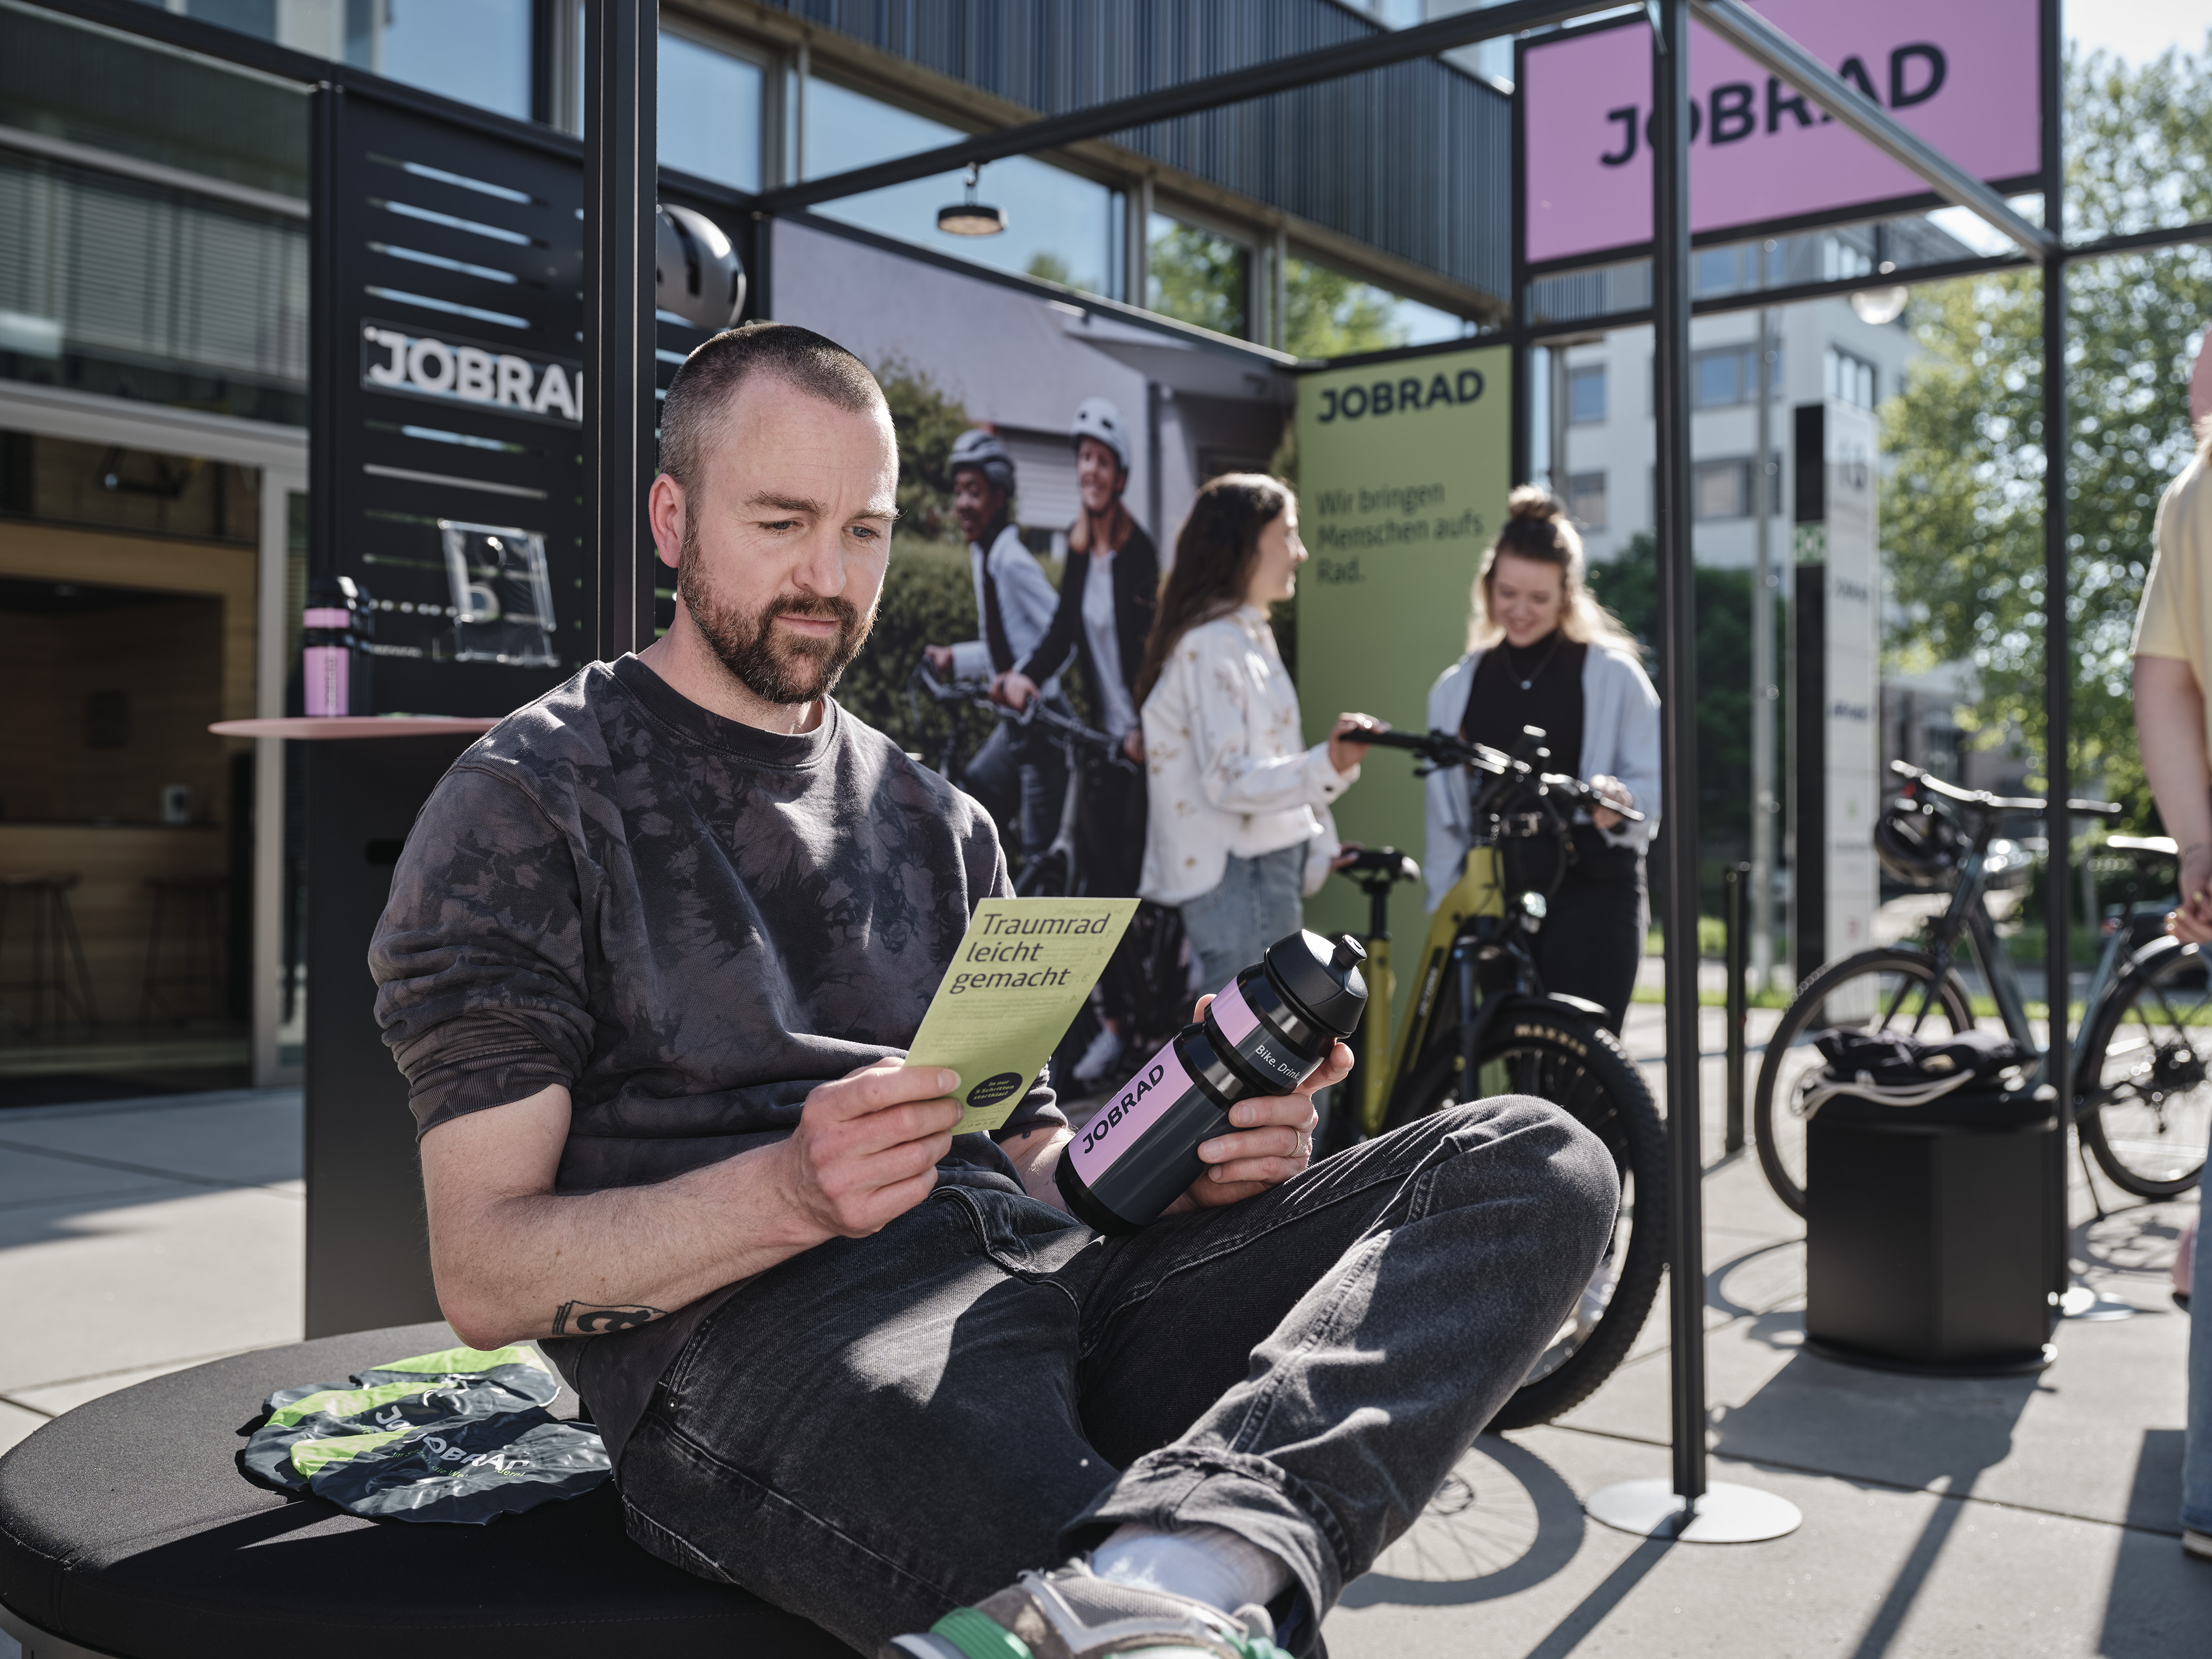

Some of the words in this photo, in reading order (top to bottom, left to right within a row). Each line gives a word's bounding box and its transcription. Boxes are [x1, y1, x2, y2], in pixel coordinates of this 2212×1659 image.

[368, 331, 583, 422] JOBRA
[1317, 369, 1485, 424] JOBRAD
[1317, 489, 1353, 517] Wir
[1358, 483, 1446, 517] bringen
[1317, 519, 1430, 550] Menschen
[1434, 508, 1485, 541] aufs
[1317, 556, 1366, 585] Rad.
[982, 914, 1111, 935] Traumrad
[966, 941, 1044, 962] leicht
[949, 967, 1072, 994] gemacht
[1255, 1045, 1276, 1067] Bike.
[1277, 1063, 1300, 1080] Drink.
[973, 1091, 1009, 1100] startklar!
[980, 1085, 1014, 1094] Schritten
[1082, 1064, 1164, 1154] JOBRAD
[432, 1465, 446, 1474] die
